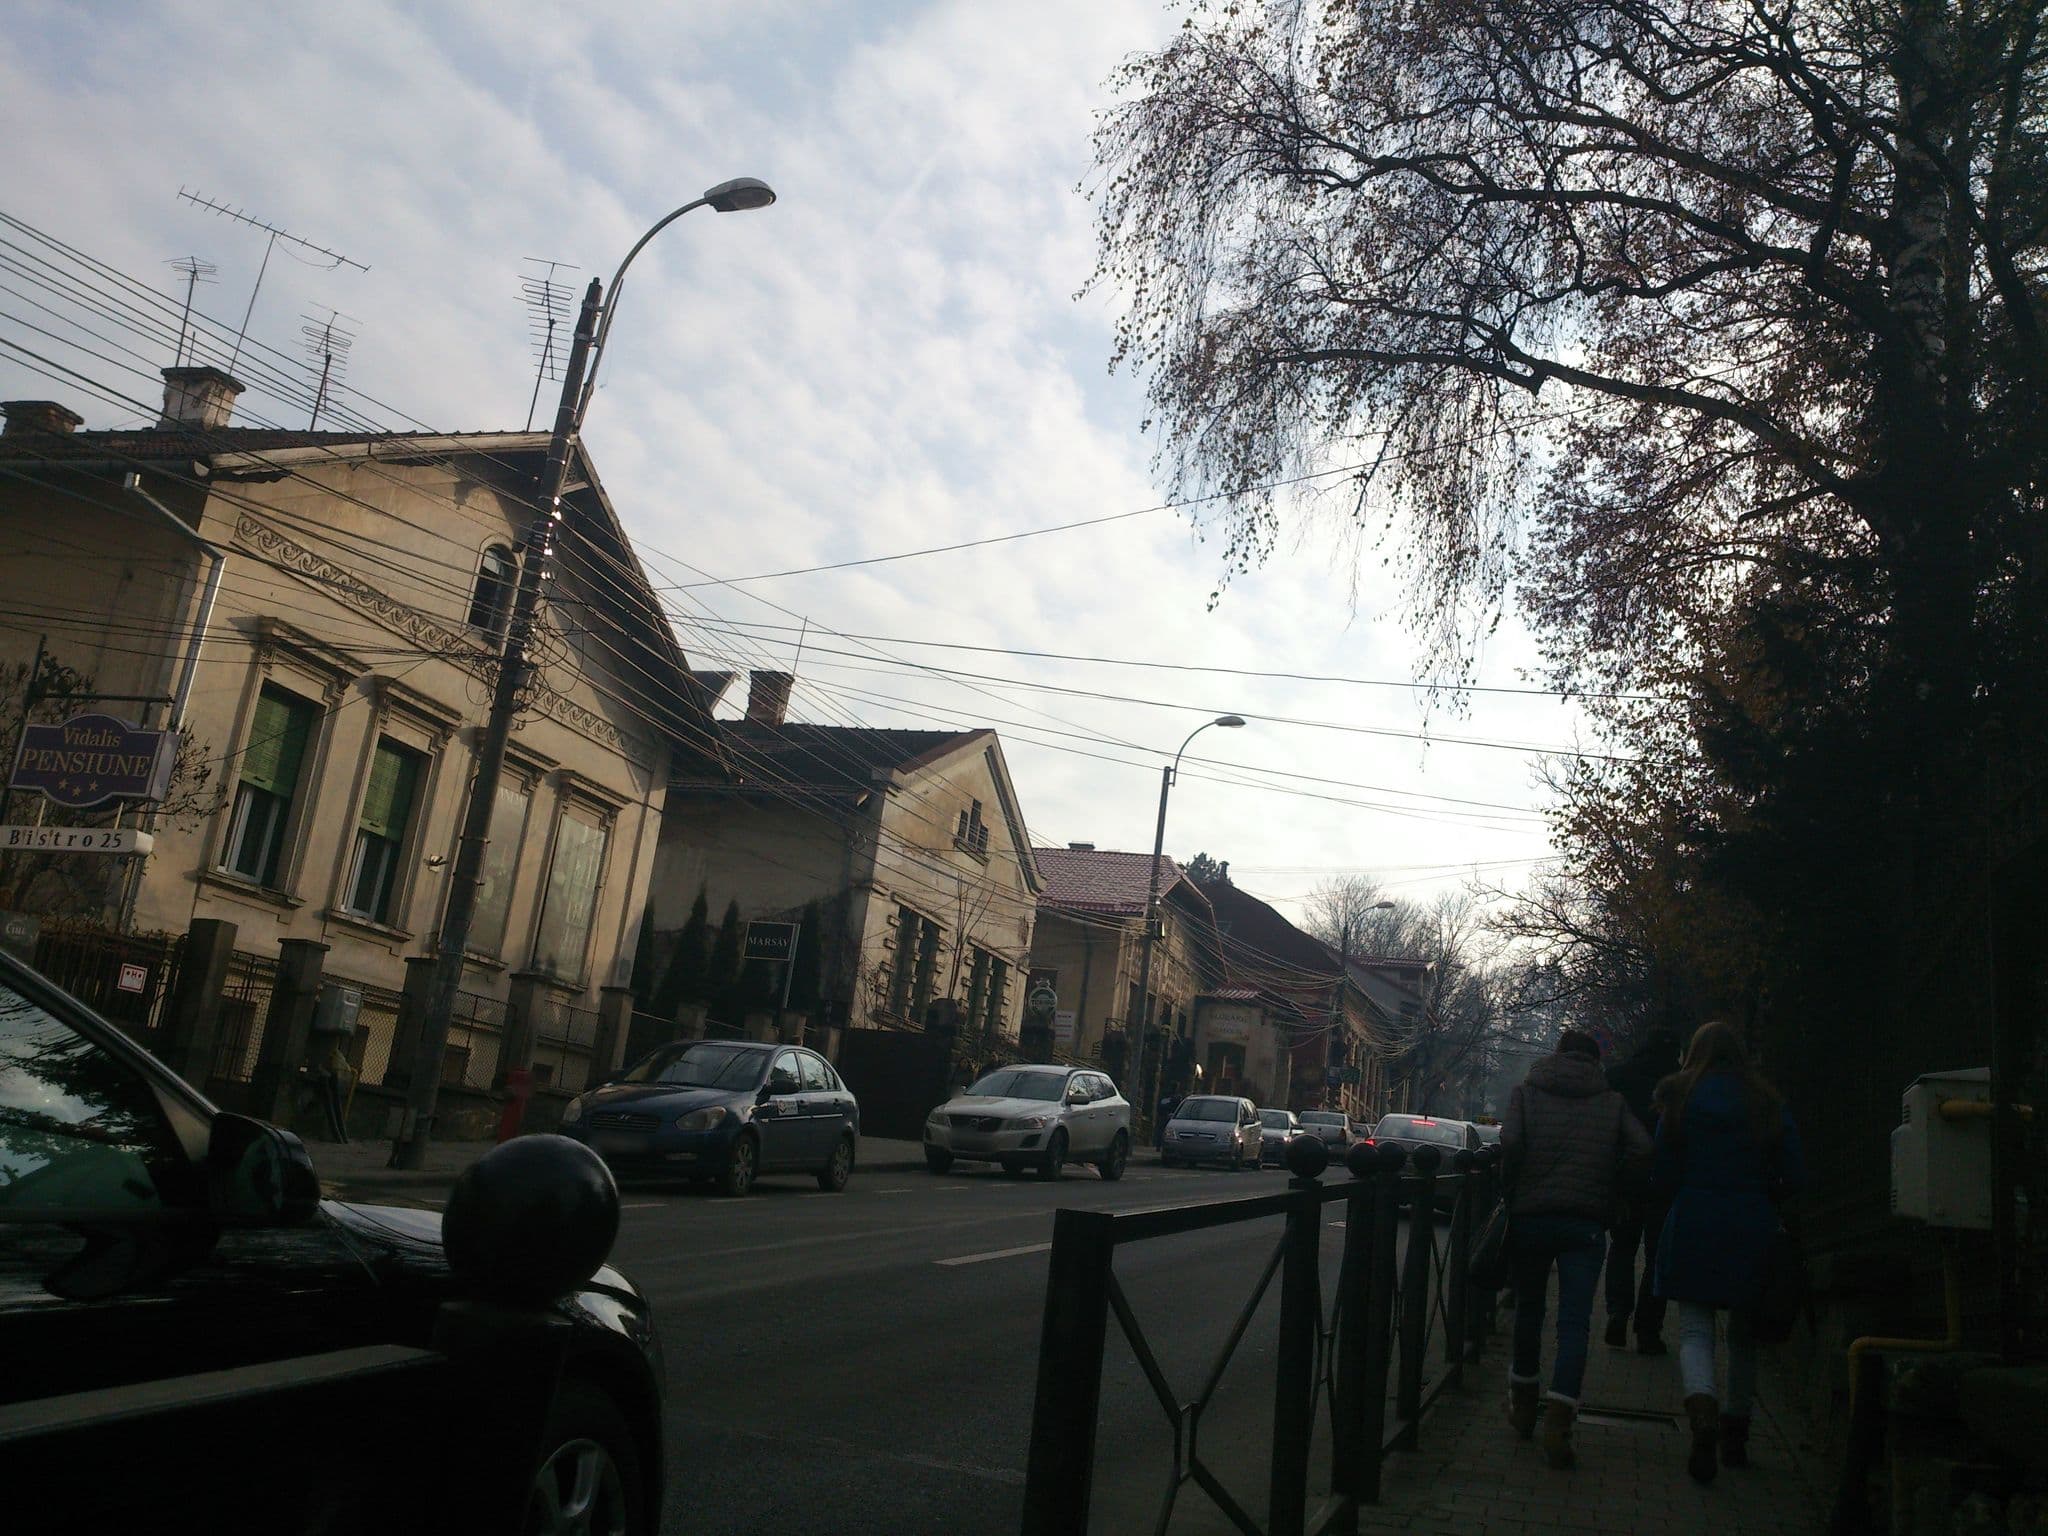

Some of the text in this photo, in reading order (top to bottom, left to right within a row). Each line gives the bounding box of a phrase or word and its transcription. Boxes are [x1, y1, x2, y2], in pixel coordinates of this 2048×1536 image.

[64, 727, 121, 747] Vidalis
[20, 748, 150, 777] PENSIUNE
[9, 830, 122, 848] Bistro 25
